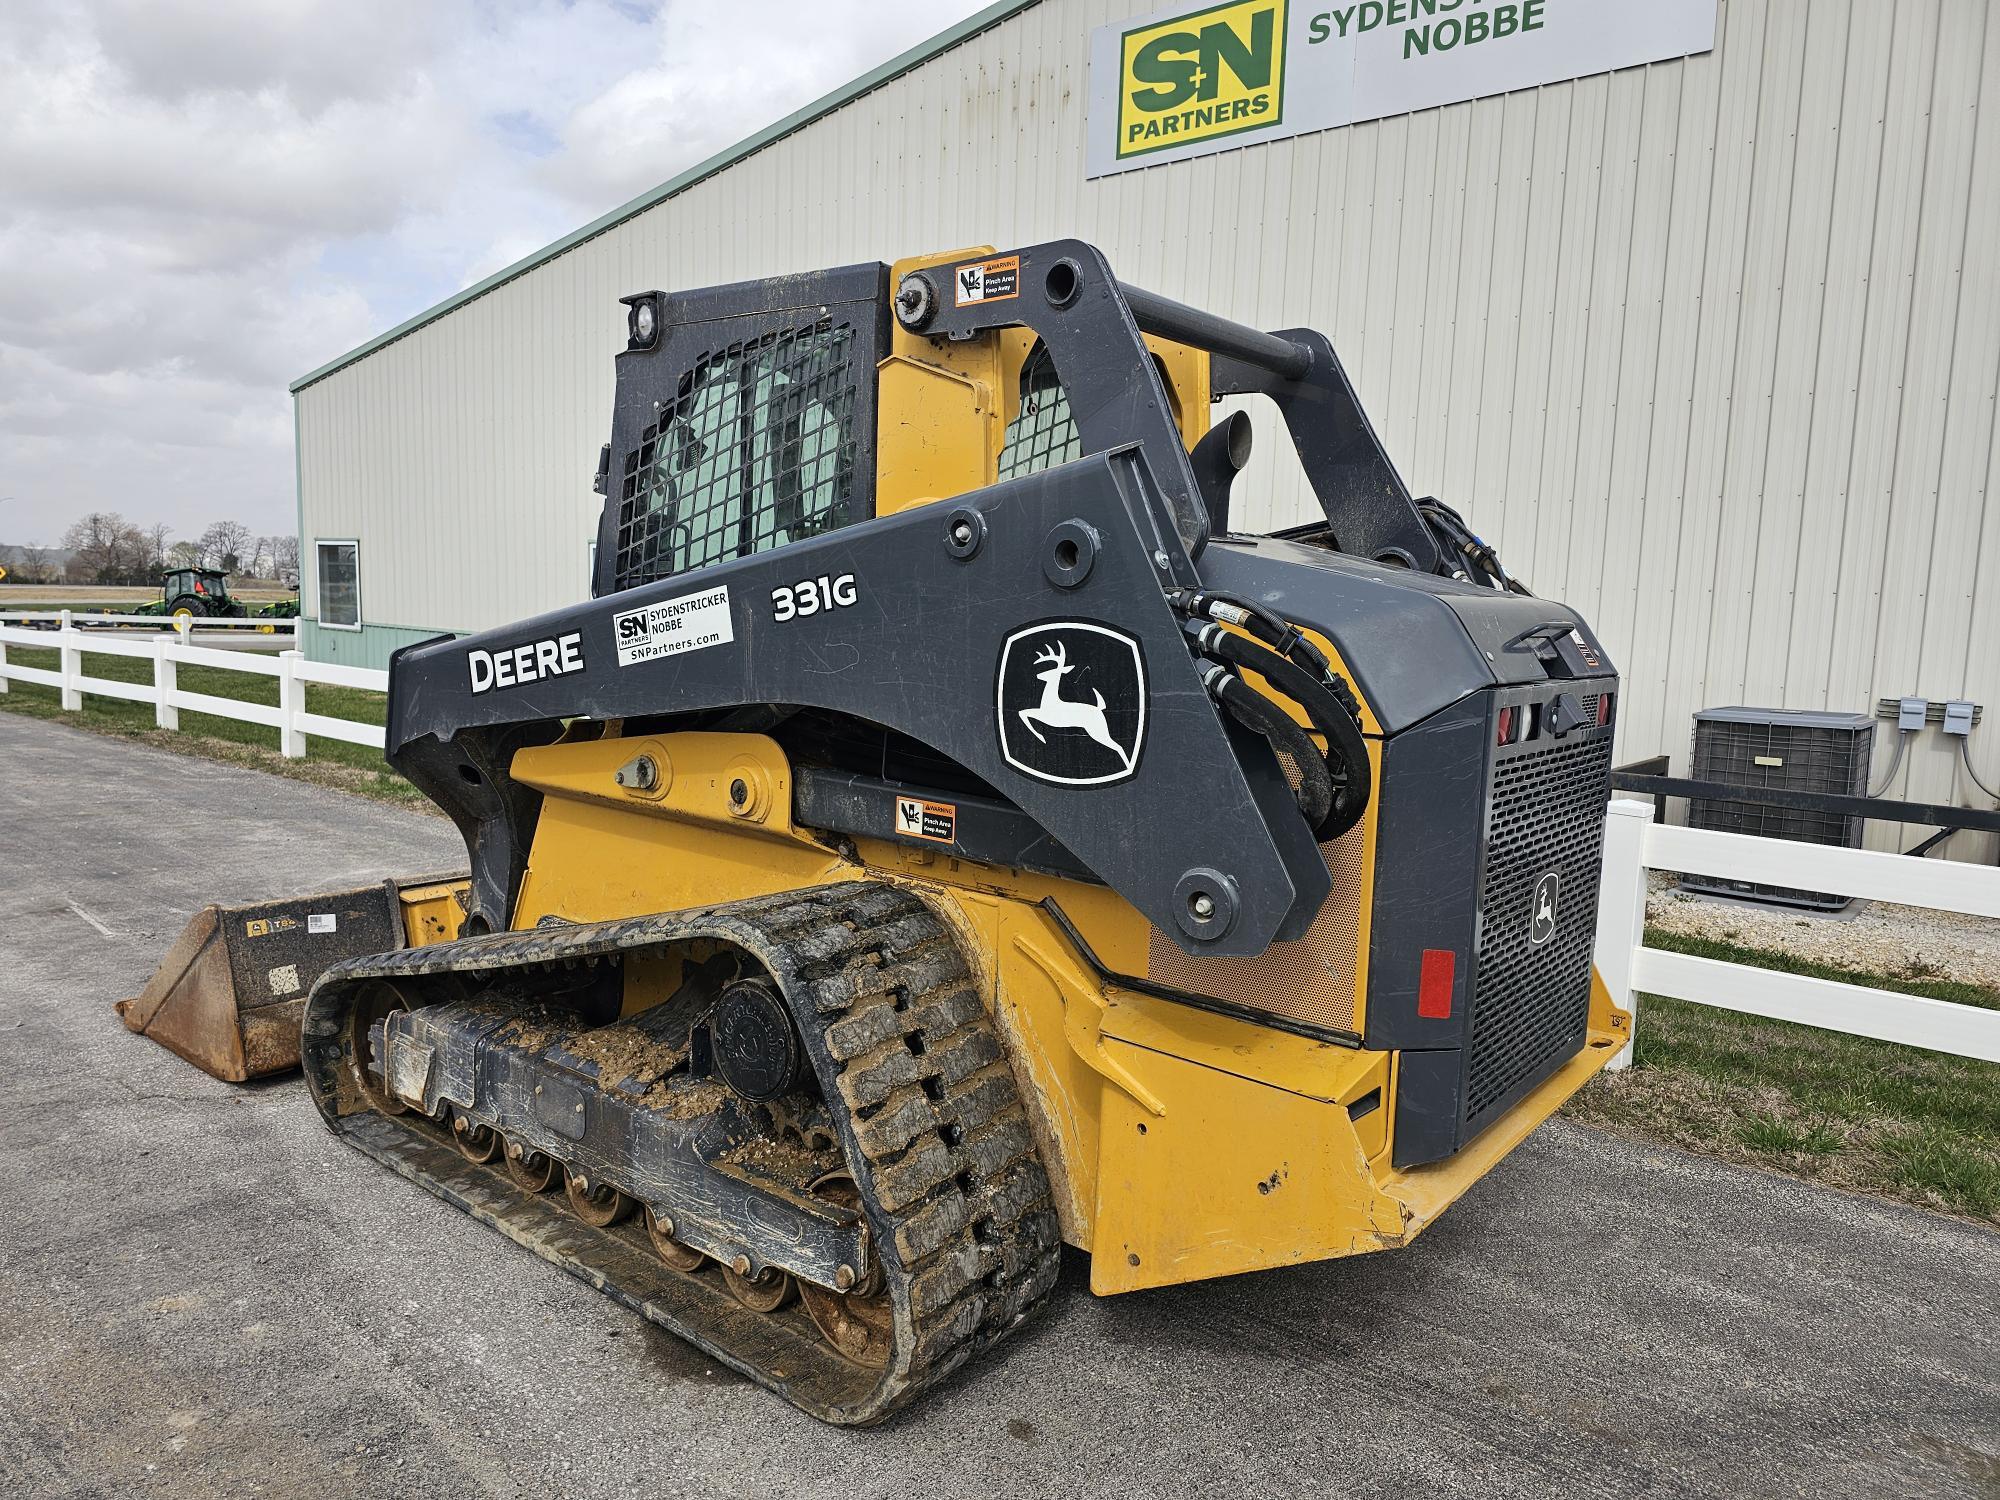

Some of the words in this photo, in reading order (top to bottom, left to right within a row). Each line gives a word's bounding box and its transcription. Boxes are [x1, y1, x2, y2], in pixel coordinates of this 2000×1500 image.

[1403, 0, 1545, 60] NOBBE
[1128, 93, 1270, 143] PARTNERS
[991, 260, 1015, 270] WARNING
[986, 278, 1001, 286] Pinch
[650, 592, 727, 622] SYDENSTRICKER
[771, 574, 858, 622] 331G
[652, 617, 683, 635] NOBBE
[621, 634, 649, 647] PARTNERS
[631, 632, 720, 660] SNPartners.com
[469, 633, 584, 693] DEERE
[930, 805, 952, 814] WARNING
[924, 817, 938, 825] Pinch
[939, 820, 951, 828] Area
[924, 825, 935, 833] Keep
